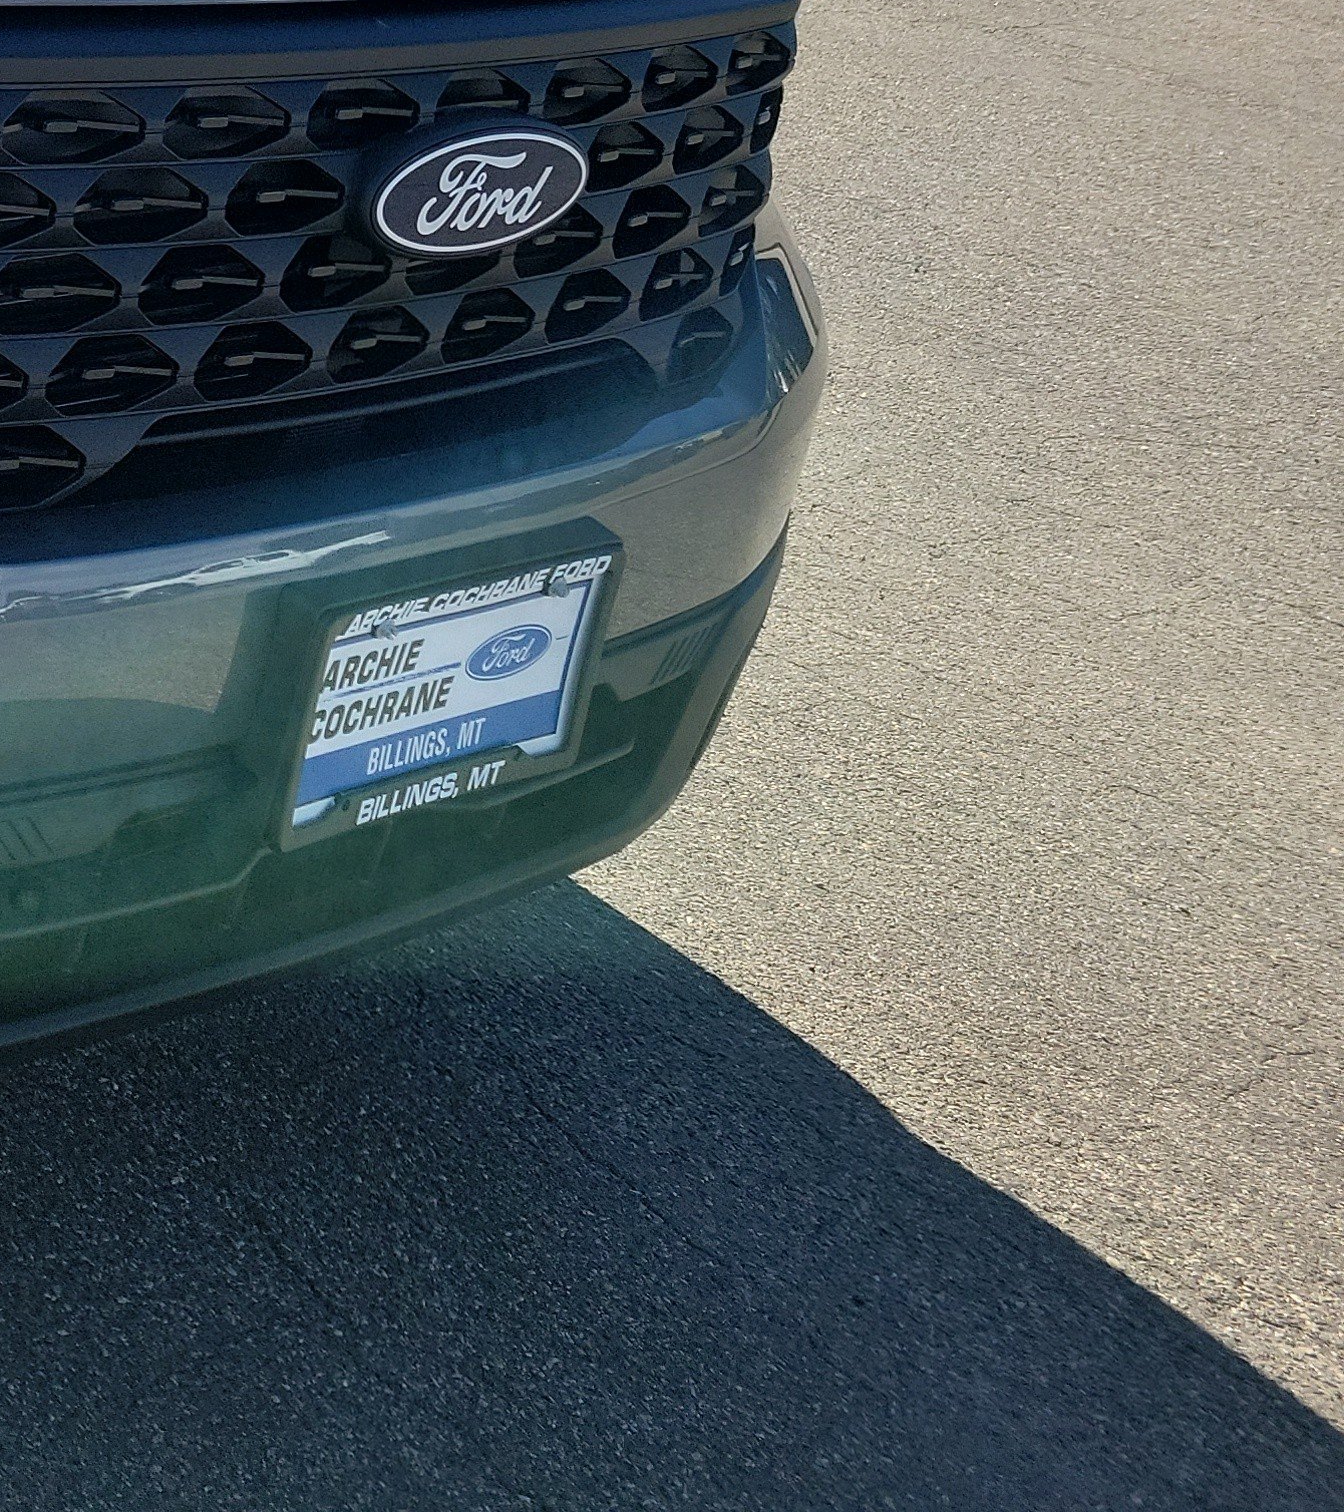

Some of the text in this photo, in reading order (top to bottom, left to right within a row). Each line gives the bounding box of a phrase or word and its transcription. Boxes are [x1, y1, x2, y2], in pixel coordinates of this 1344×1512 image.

[416, 151, 554, 236] Ford
[344, 554, 613, 637] ARCHIE COCHRANE FORD
[321, 638, 425, 693] ARCHIE
[482, 634, 535, 673] Ford
[312, 675, 456, 742] COCHRANE
[366, 718, 487, 776] BILLINGS, MT
[356, 760, 507, 826] BILLINGS, MT
